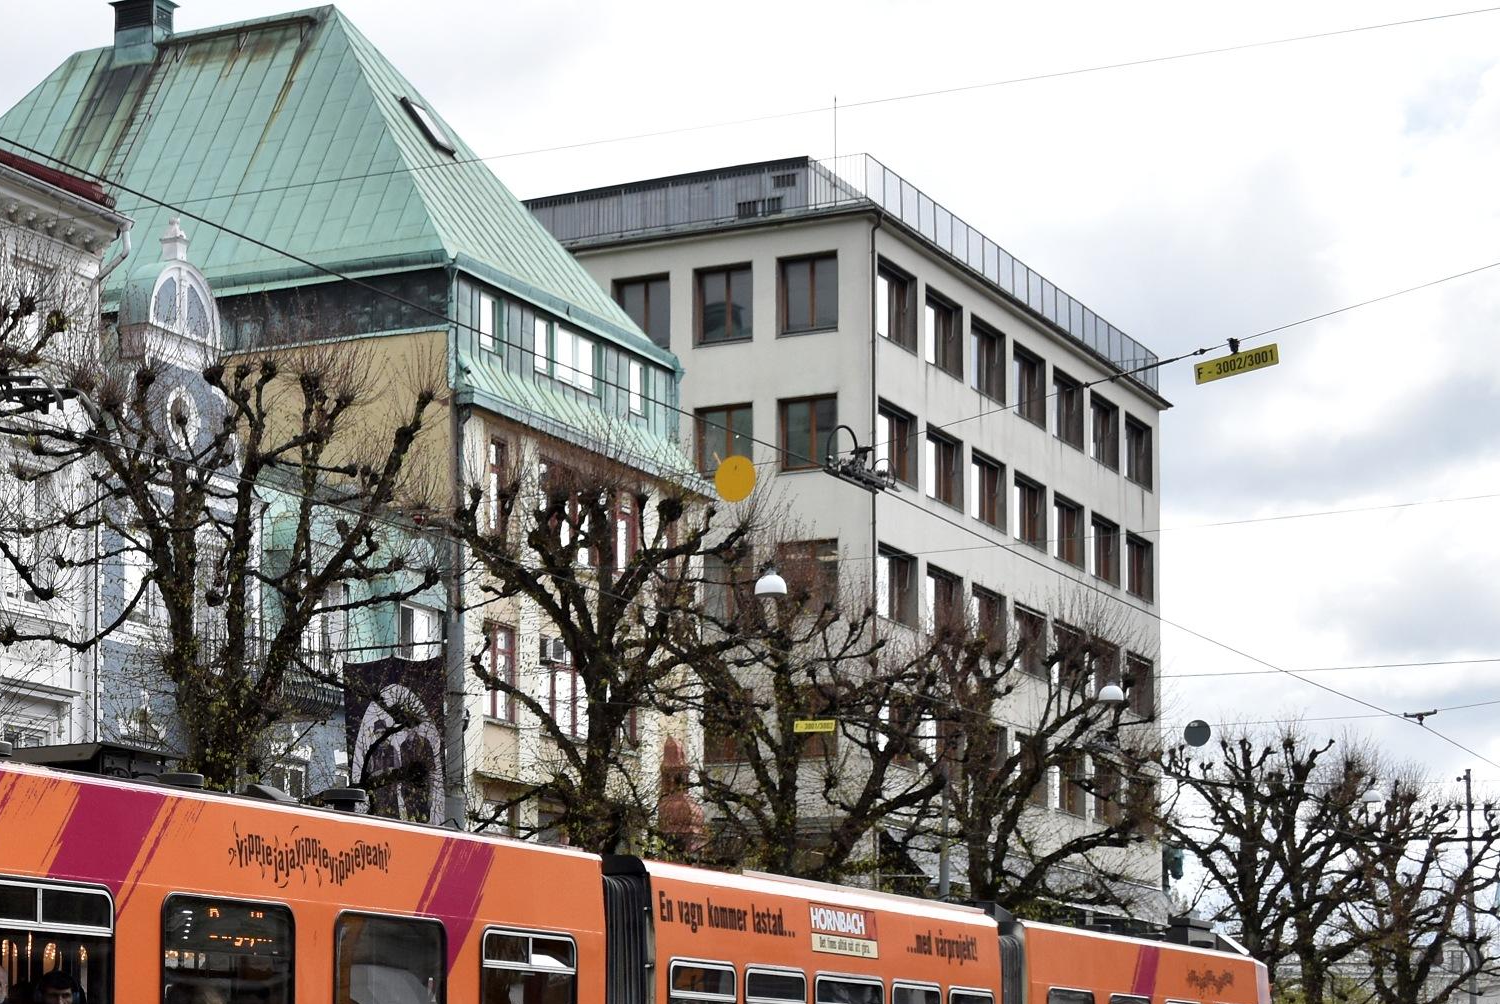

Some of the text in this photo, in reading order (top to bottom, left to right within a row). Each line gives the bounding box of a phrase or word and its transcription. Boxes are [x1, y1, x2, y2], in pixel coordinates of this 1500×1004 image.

[1197, 367, 1203, 380] F
[1215, 349, 1275, 375] 3002/3001
[658, 890, 796, 938] En vagn kommer lastad...
[810, 906, 866, 935] HORNBACH
